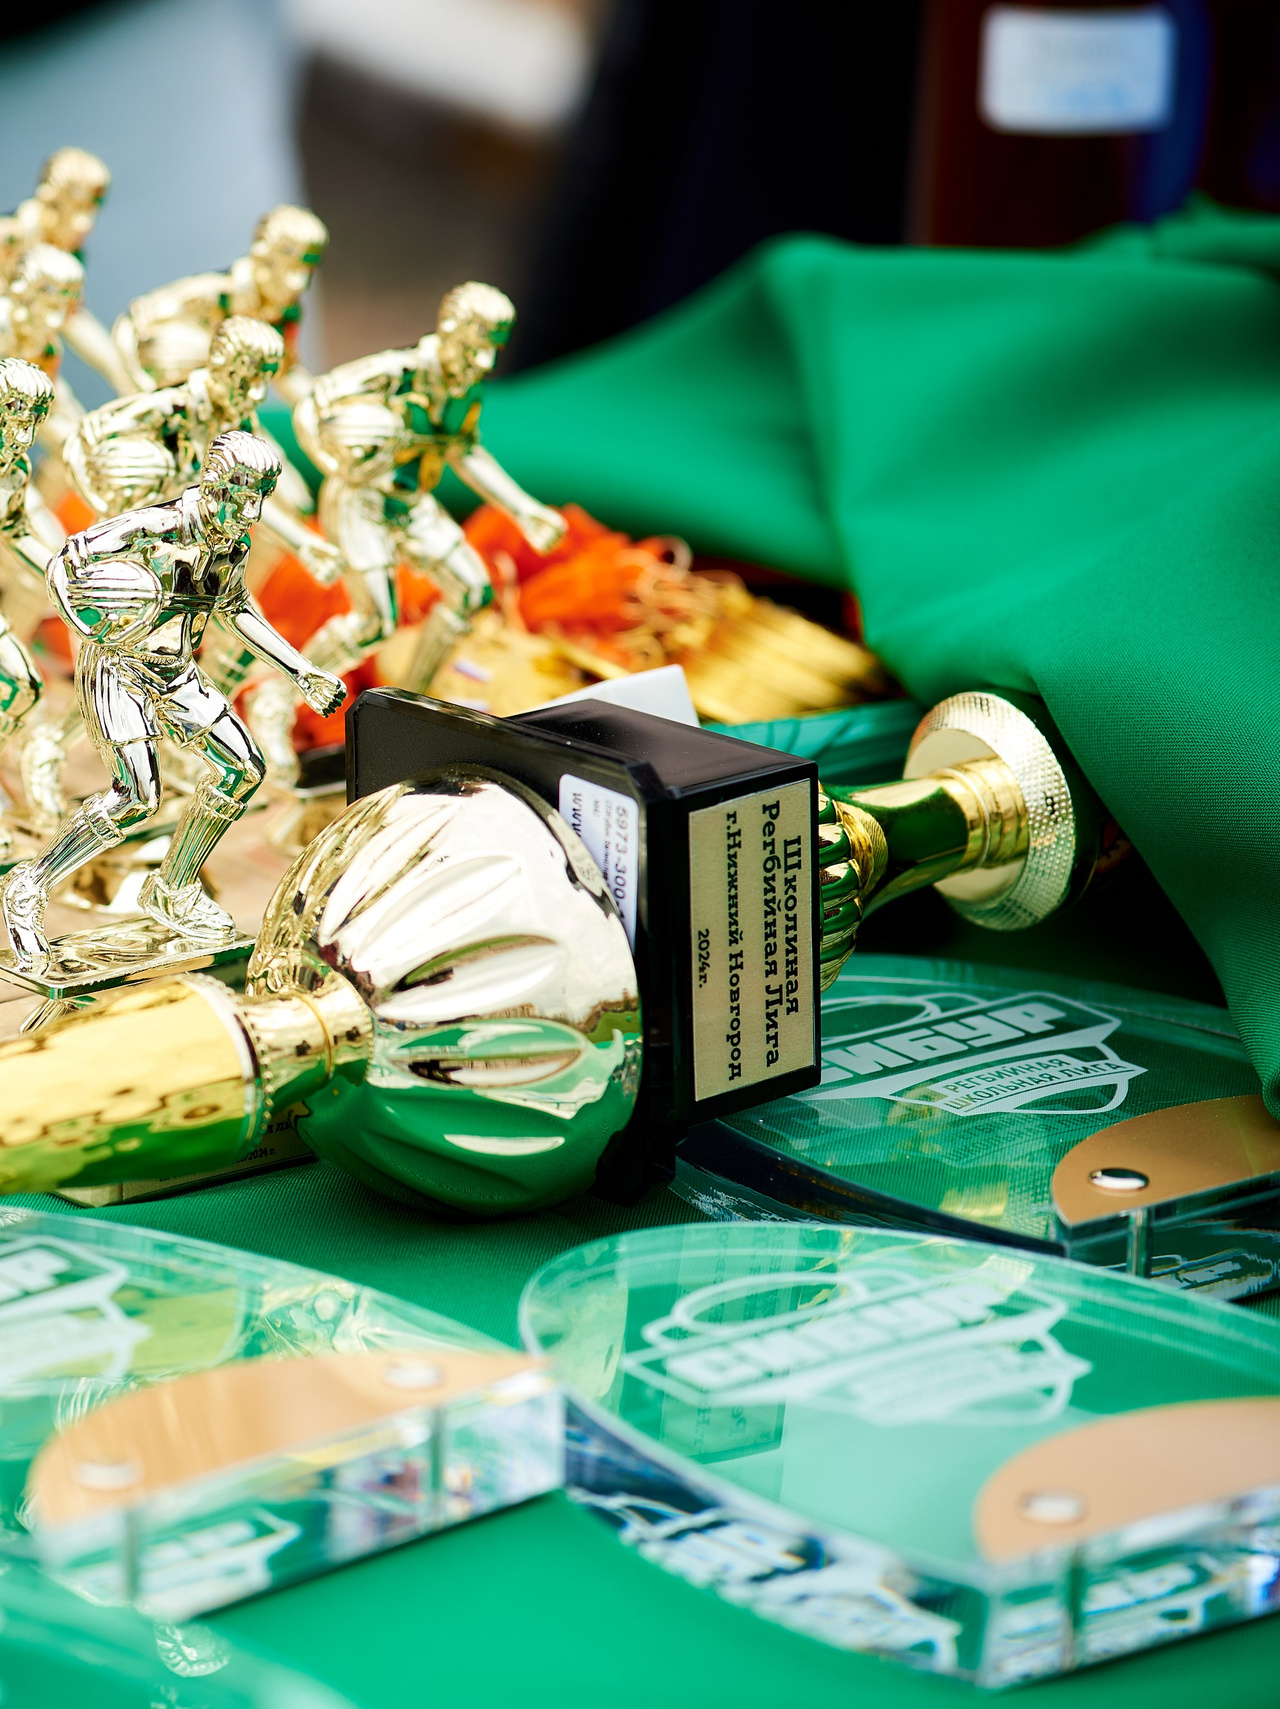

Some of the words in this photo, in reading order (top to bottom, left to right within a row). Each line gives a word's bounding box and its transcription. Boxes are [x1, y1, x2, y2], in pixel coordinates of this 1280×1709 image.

[726, 811, 744, 946] г.Нижний
[762, 800, 782, 979] Регбийная
[783, 835, 802, 1016] Школиная
[697, 928, 710, 989] 2024г.
[726, 950, 744, 1081] Новгород
[765, 984, 783, 1068] Лига
[942, 1058, 1072, 1093] РЕГБИЙНАЯ
[944, 1073, 1060, 1110] ШКОЛЬНАЯ
[1060, 1062, 1127, 1078] ЛИГА
